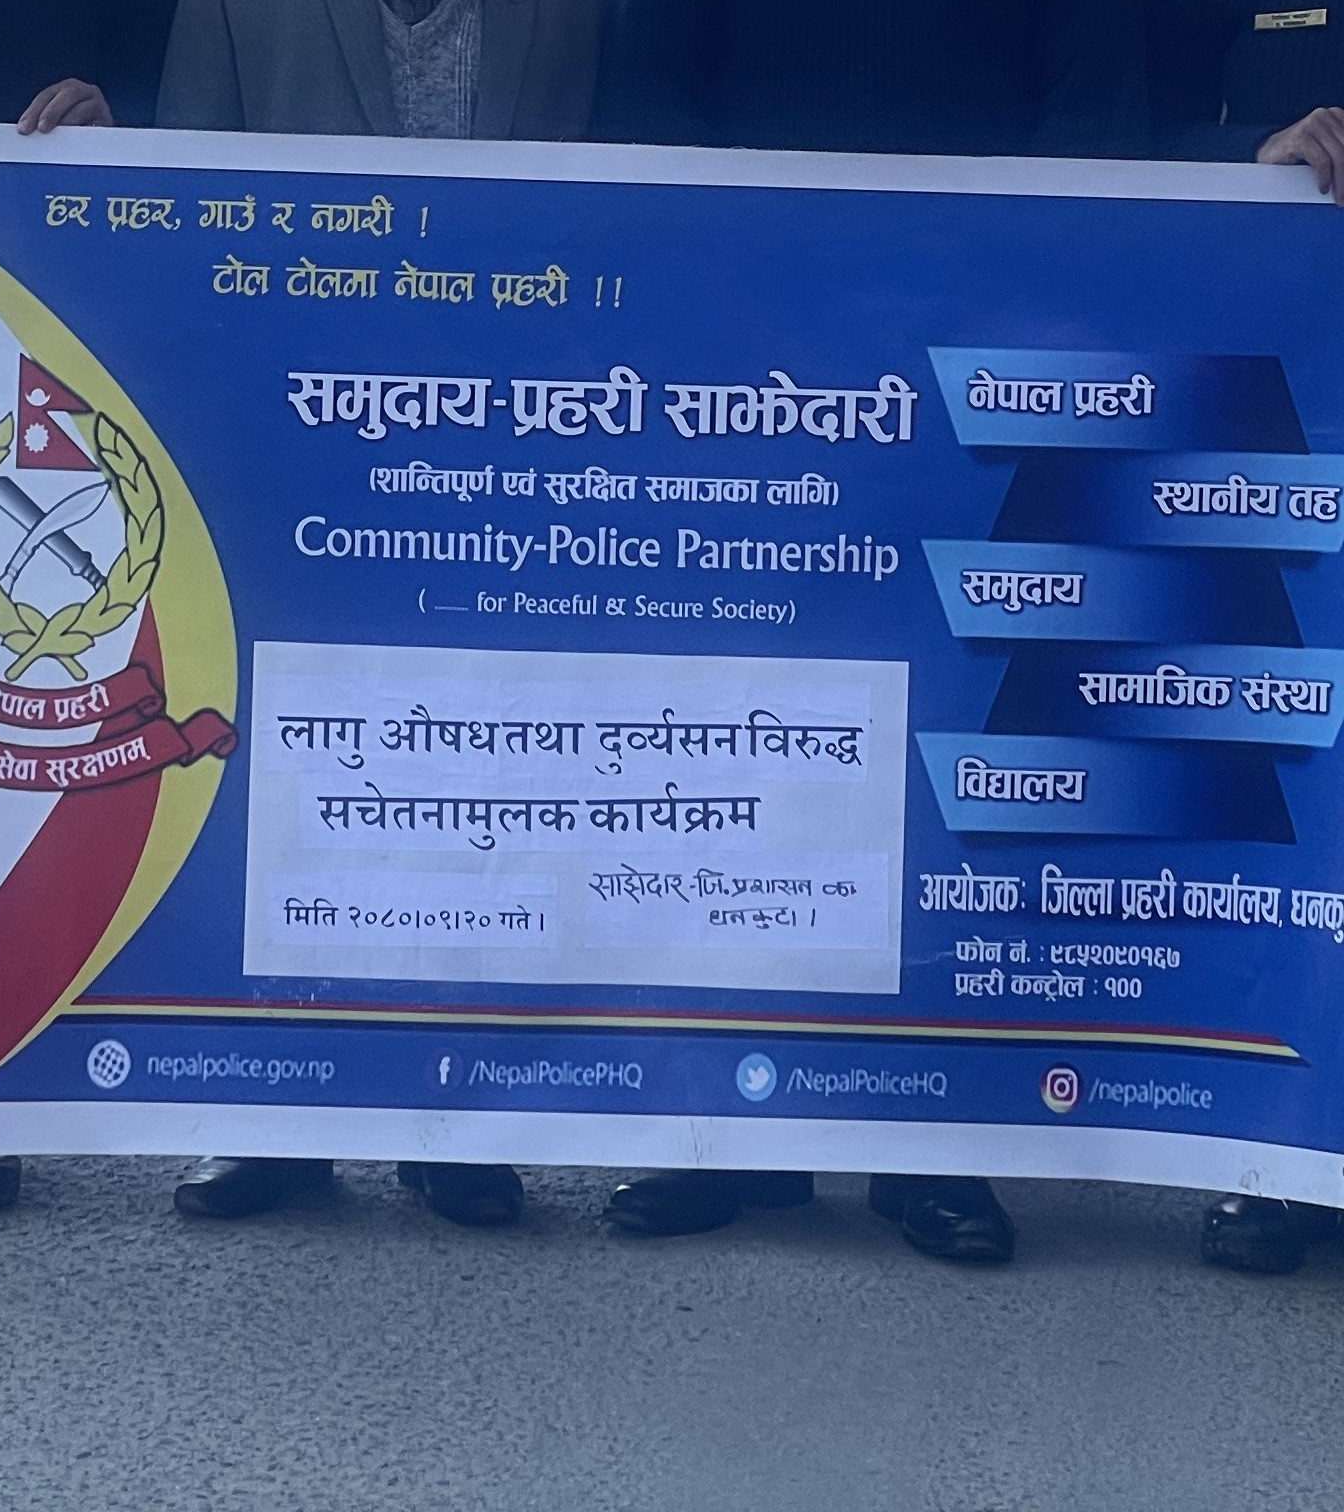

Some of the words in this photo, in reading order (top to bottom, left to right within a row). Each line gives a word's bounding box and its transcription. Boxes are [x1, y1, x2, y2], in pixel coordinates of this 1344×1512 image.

[45, 194, 91, 228] हर
[107, 196, 182, 232] प्रहर,
[198, 195, 257, 233] गाउँ
[272, 203, 296, 234] र
[310, 195, 395, 236] नगरी
[211, 254, 271, 296] टोल
[285, 257, 380, 299] टोलमा
[394, 260, 476, 302] नेपाल
[491, 265, 571, 310] प्रहरी
[286, 365, 649, 441] समुदाय-प्रहरी
[663, 369, 918, 444] साझेदारी
[969, 369, 1064, 414] नेपाल
[1073, 374, 1156, 417] प्रहरी
[502, 466, 536, 502] एवं
[543, 465, 637, 508] सुरक्षित
[644, 474, 759, 505] समाजका
[765, 472, 841, 507] लागि)
[1154, 475, 1281, 517] स्थानीय
[1289, 485, 1341, 522] तह
[294, 515, 661, 571] Community-Police
[676, 528, 900, 582] Partnership
[476, 590, 508, 614] for
[513, 591, 598, 617] Peaceful
[604, 596, 627, 617] &
[634, 596, 705, 620] Secure
[711, 597, 796, 625] Society)
[962, 569, 1083, 613] समुदाय
[53, 682, 110, 724] प्रहरी
[1079, 665, 1234, 709] सामाजिक
[1241, 672, 1331, 716] संस्था
[277, 715, 365, 771] लागु
[503, 721, 585, 757] तथा
[956, 758, 1086, 803] विद्यालय
[317, 782, 579, 850] सचेतनामुलक
[586, 782, 762, 834] कार्यक्रम
[284, 896, 338, 929] मिति
[498, 904, 534, 931] गते
[1040, 864, 1115, 918] जिल्ला
[1122, 868, 1176, 922] प्रहरी
[1183, 874, 1284, 929] कार्यालय,
[956, 935, 1002, 964] फोन
[955, 969, 1004, 997] प्रहरी
[1011, 970, 1084, 1004] कन्ट्रोल
[1103, 977, 1143, 999] १००
[147, 1053, 336, 1084] nepalpolice.gov.np
[785, 1067, 949, 1099] /NepalPoliceHQ
[1089, 1078, 1214, 1111] /nepalpolice
